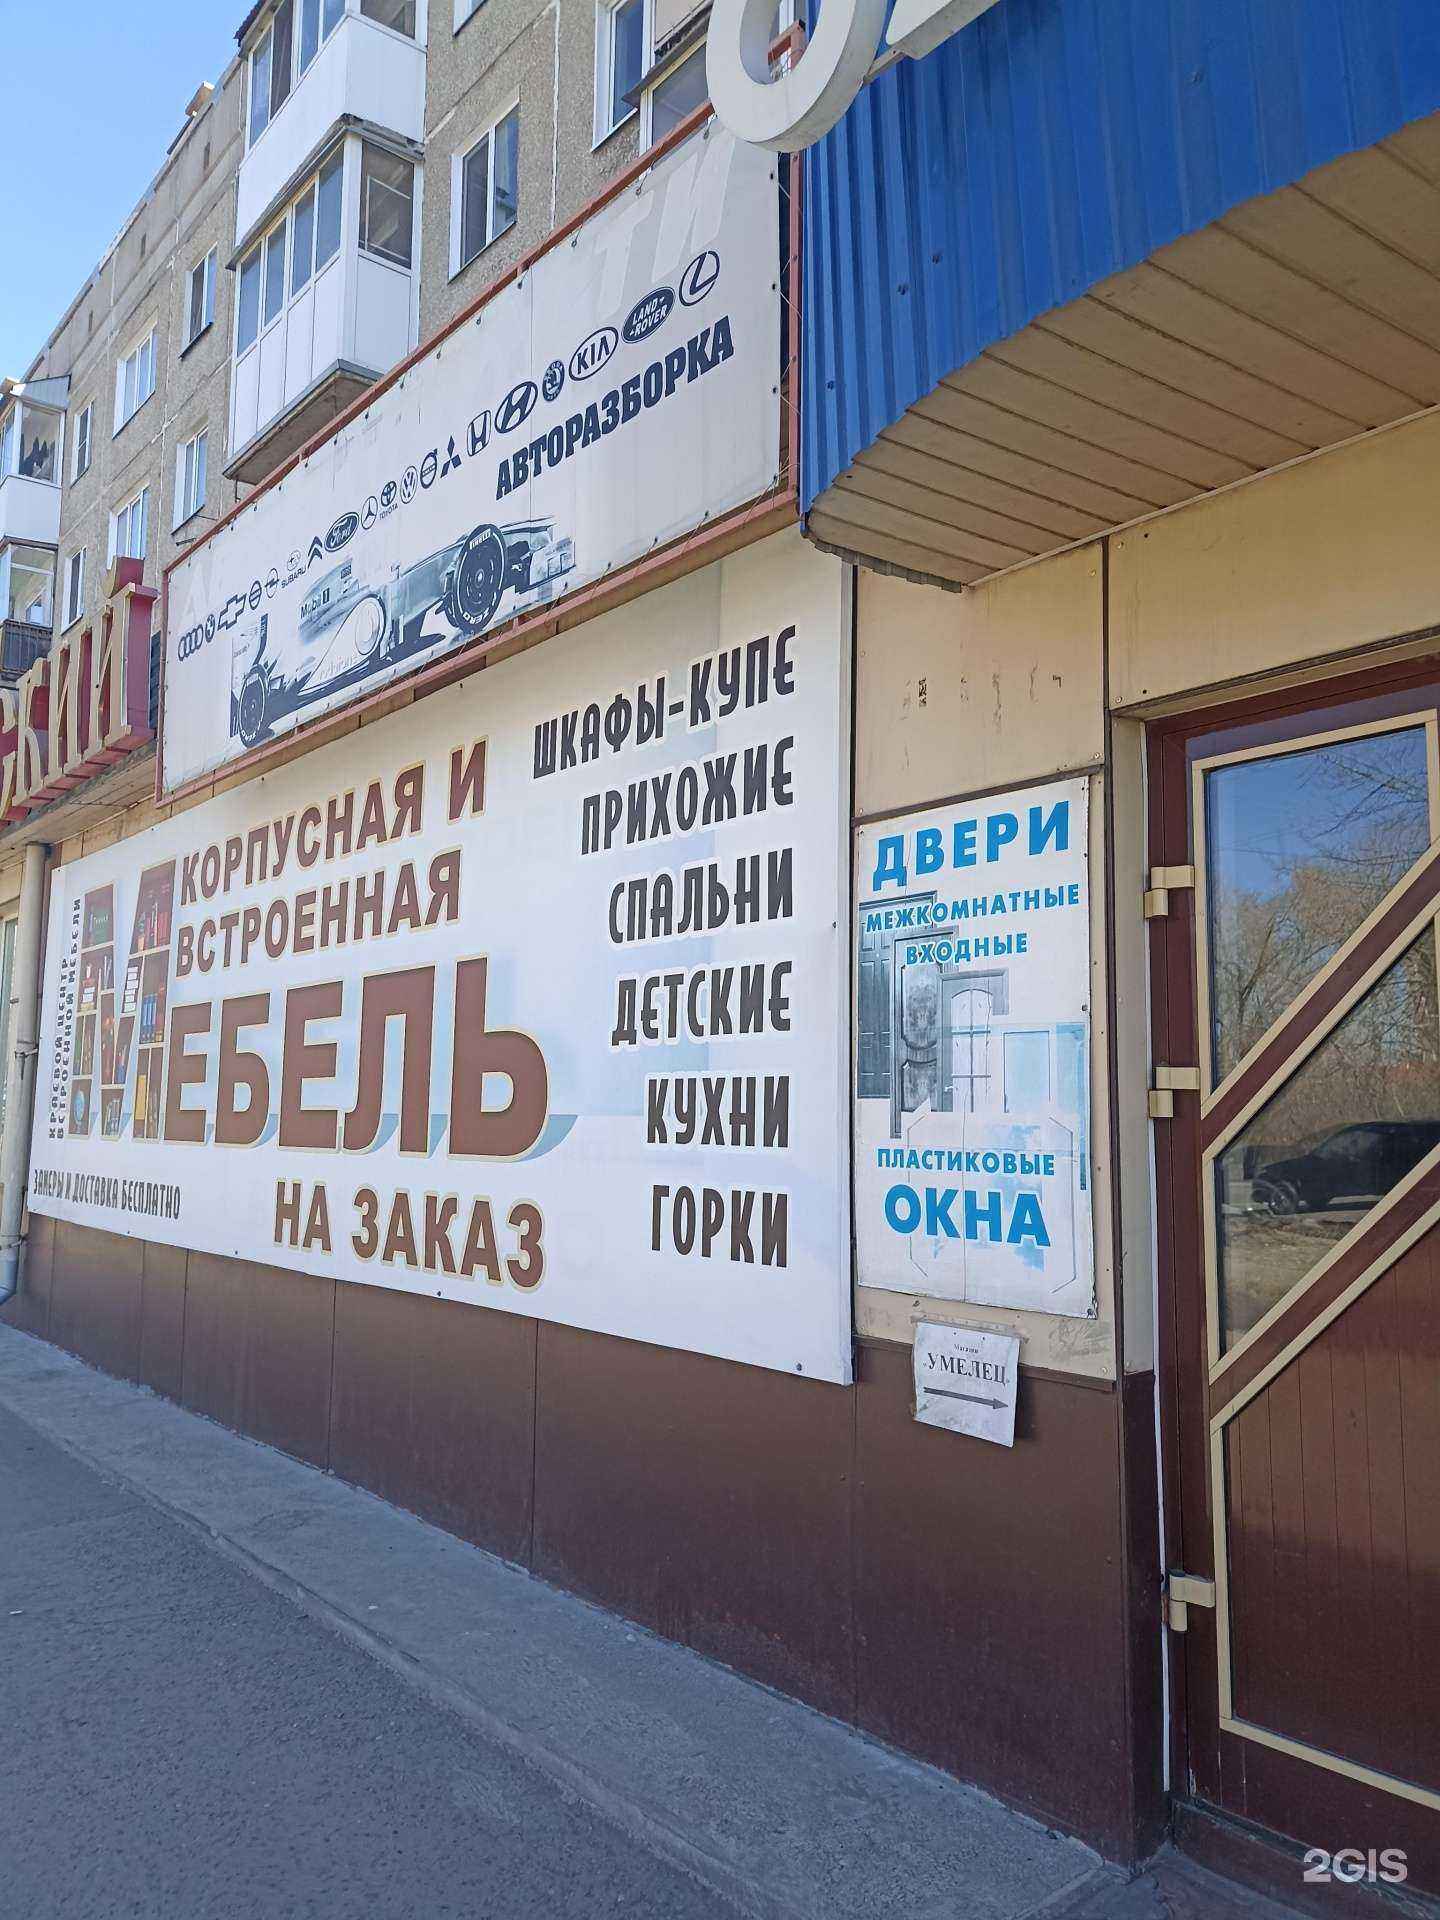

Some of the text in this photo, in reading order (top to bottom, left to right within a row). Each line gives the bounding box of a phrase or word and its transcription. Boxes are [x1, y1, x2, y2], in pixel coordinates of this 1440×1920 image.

[632, 299, 658, 325] LAND
[635, 305, 668, 337] ROVER
[577, 336, 611, 374] KIA
[496, 315, 734, 501] АВТОРАЗБОРКА
[281, 564, 306, 588] SUBARU
[533, 624, 796, 779] ШКАФЫ-КУПЕ
[180, 738, 487, 907] КОРПУСНАЯ И
[581, 735, 794, 855] ПРИХОЖИЕ
[872, 800, 1069, 891] ДВЕРИ
[176, 849, 462, 977] ВСТРОЕННАЯ
[609, 848, 793, 943] СПАЛЬНИ
[865, 883, 1079, 932] МЕЖКОМНАТНЫЕ
[906, 933, 1028, 965] ВХОДНЫЕ
[611, 961, 793, 1046] ДЕТСКИЕ
[647, 1076, 790, 1148] КУХНИ
[33, 1169, 64, 1199] ЗАМЕРЫ
[72, 1173, 119, 1209] ДОСТАВКА
[121, 1180, 181, 1220] БЕСПЛАТНО
[877, 1148, 1055, 1176] ПЛАСТИКОВЫЕ
[274, 1179, 545, 1289] НА ЗАКАЗ
[652, 1184, 788, 1268] ГОРКИ
[884, 1184, 1051, 1247] ОКНА
